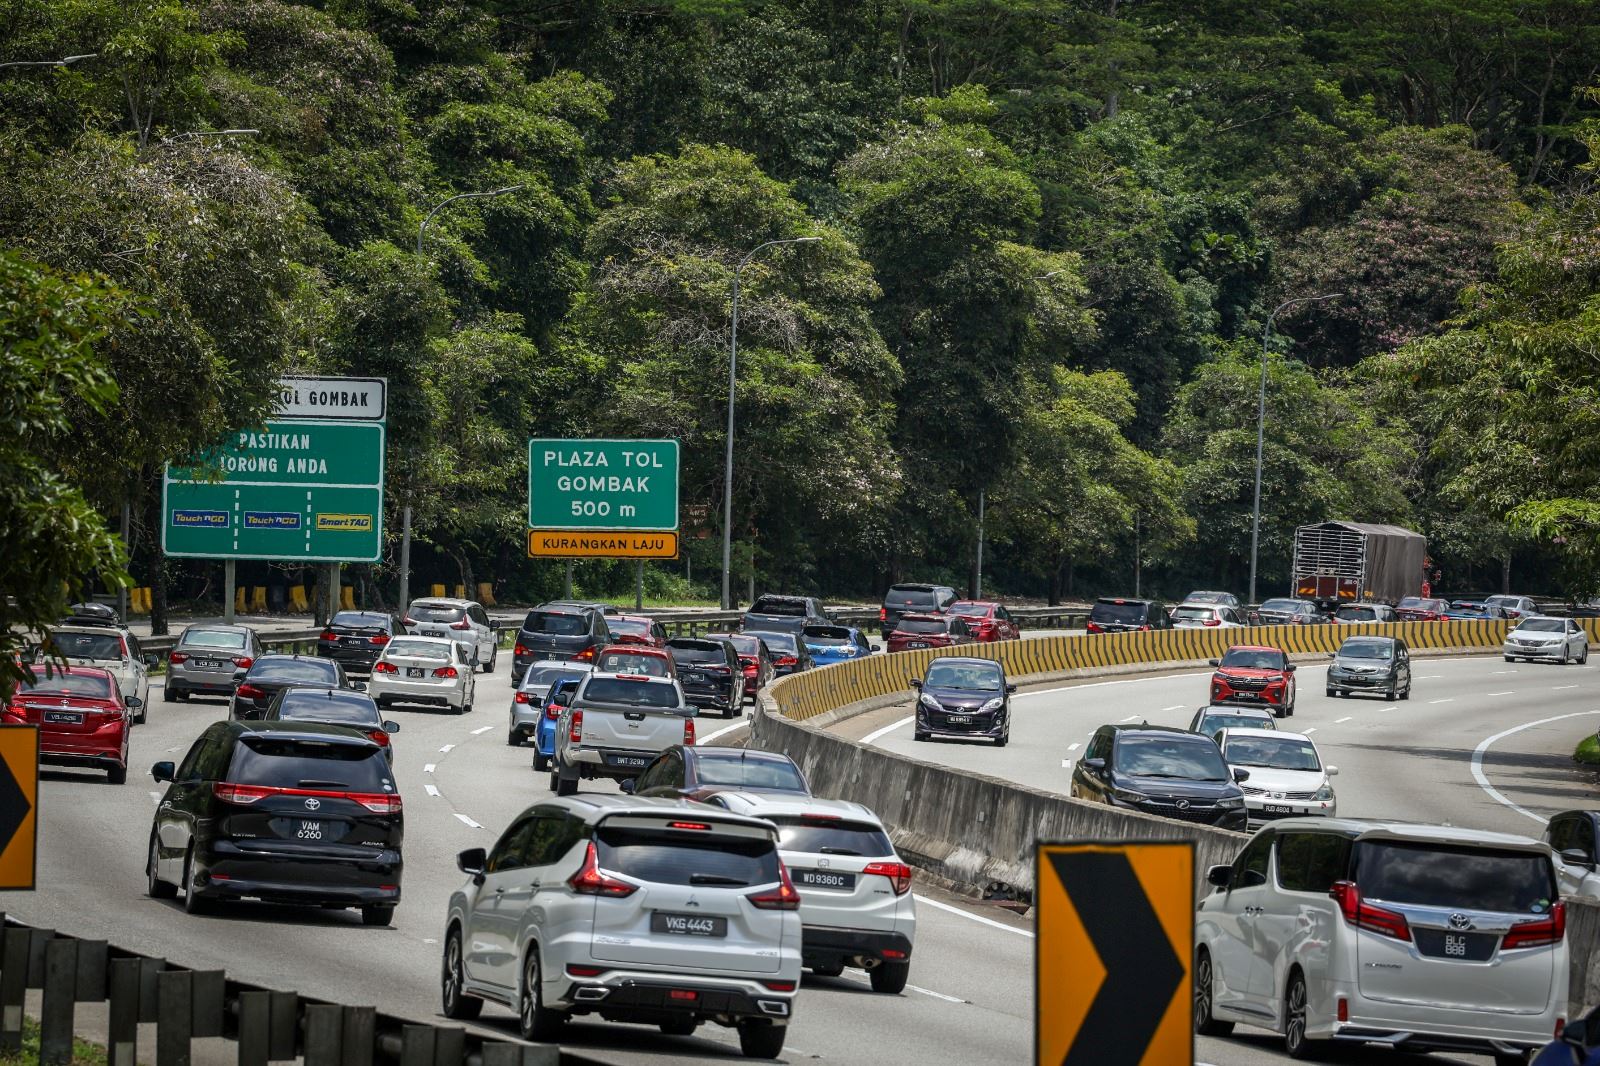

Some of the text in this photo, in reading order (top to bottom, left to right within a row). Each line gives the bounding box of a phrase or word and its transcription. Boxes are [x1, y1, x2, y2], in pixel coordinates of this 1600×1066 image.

[283, 391, 368, 407] OL GOMBAK
[239, 433, 310, 449] PASTIKAN
[287, 458, 328, 474] ANDA
[544, 451, 663, 468] PLAZA TOL
[557, 476, 650, 492] GOMBAK
[571, 501, 636, 517] 500 m
[543, 538, 664, 550] KURANGKAN LAJU
[301, 821, 320, 831] VAM
[297, 830, 322, 839] 6260
[803, 873, 815, 882] WD
[665, 917, 713, 932] VKG 4443
[1445, 935, 1465, 946] BLC
